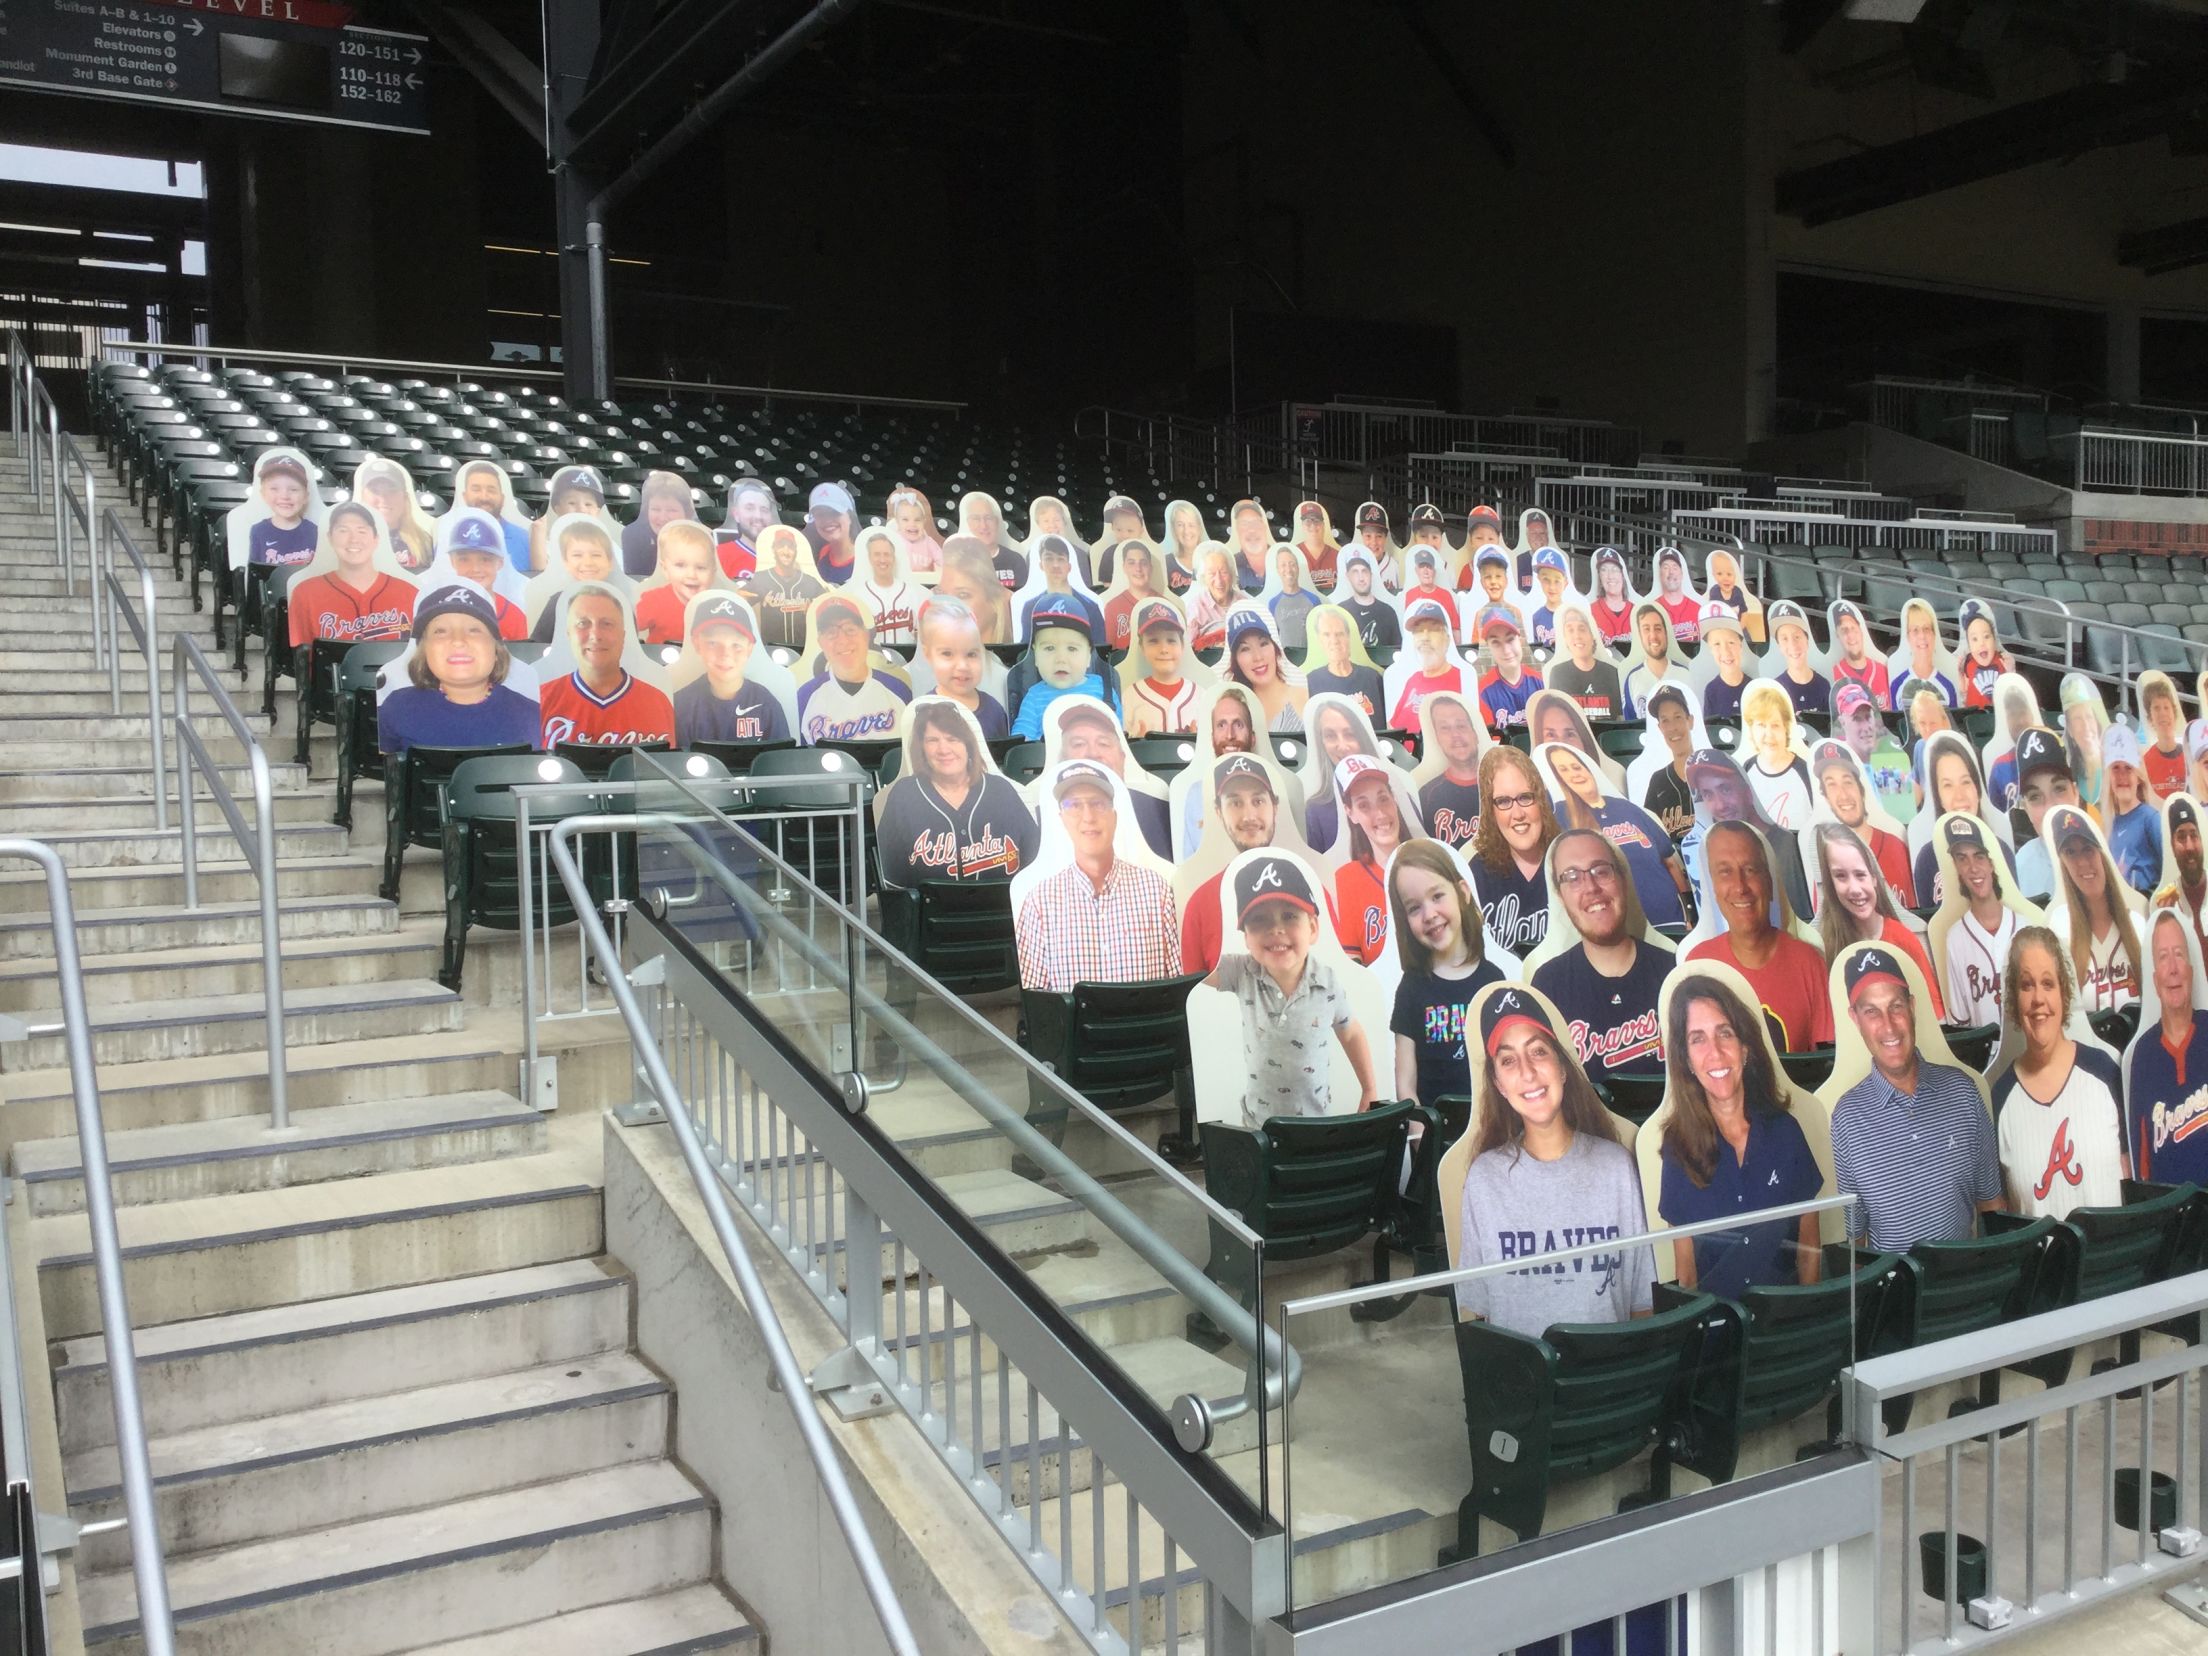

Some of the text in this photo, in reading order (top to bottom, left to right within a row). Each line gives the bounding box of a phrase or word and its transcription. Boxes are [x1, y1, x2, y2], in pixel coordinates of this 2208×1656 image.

[54, 0, 95, 15] Suites
[129, 9, 140, 21] &
[102, 22, 161, 41] Elevators
[94, 37, 162, 56] Restrooms
[339, 41, 400, 61] 120-151
[45, 47, 162, 73] Monument Garden
[72, 67, 163, 89] 3rd Base Gate
[340, 66, 401, 87] 110-118
[340, 84, 402, 105] 152-162
[571, 472, 590, 486] A
[1366, 507, 1380, 520] A
[1421, 507, 1435, 520] A
[463, 523, 481, 539] A
[1541, 551, 1555, 564] A
[443, 587, 471, 604] A
[710, 600, 735, 616] A
[1048, 600, 1067, 614] A
[1778, 604, 1790, 616] A
[319, 607, 398, 640] Braves
[1232, 611, 1257, 630] ATL
[1585, 683, 1595, 694] A
[736, 717, 764, 739] ATL
[807, 708, 897, 741] Braves
[2023, 731, 2045, 760] A
[1227, 757, 1251, 775] A
[1694, 749, 1710, 766] A
[1434, 807, 1480, 844] Bra
[1601, 820, 1636, 841] aves
[2063, 813, 2081, 830] A
[908, 822, 1003, 867] Atlanta
[1252, 862, 1283, 892] A
[1858, 951, 1881, 973] A
[1494, 991, 1521, 1015] A
[1567, 1008, 1660, 1063] Braves
[1453, 1044, 1466, 1060] A
[2033, 1116, 2084, 1201] A
[1767, 1169, 1780, 1186] A
[1595, 1256, 1617, 1297] A
